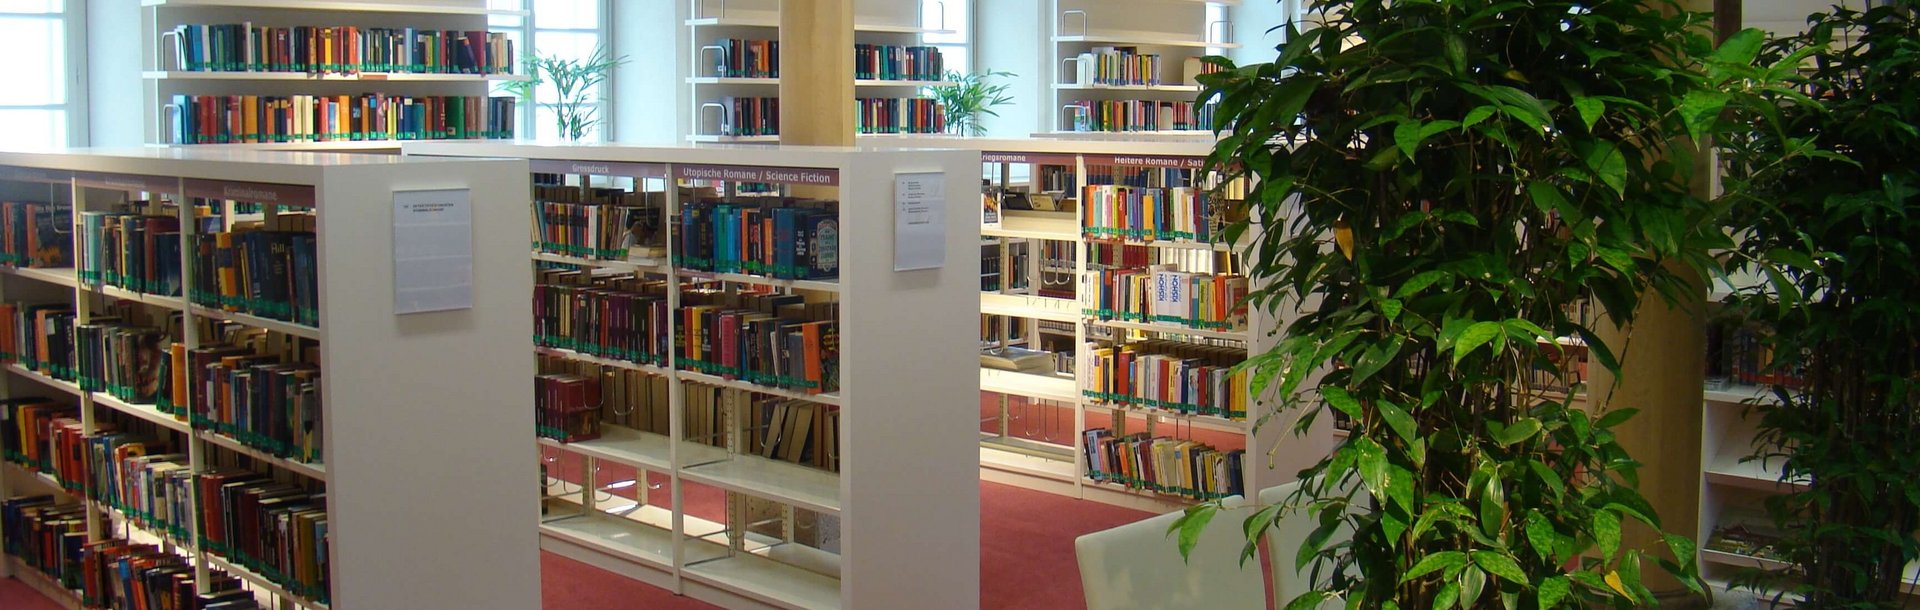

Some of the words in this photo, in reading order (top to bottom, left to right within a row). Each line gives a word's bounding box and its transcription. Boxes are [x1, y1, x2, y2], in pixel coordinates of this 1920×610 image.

[982, 153, 1026, 162] riegsromane
[1114, 156, 1143, 165] Heitere
[1145, 157, 1178, 166] Romane
[1187, 158, 1206, 167] Sati
[572, 164, 609, 174] Grossdruck
[683, 167, 721, 179] Utopische
[724, 169, 756, 180] Romane
[759, 170, 764, 181] /
[766, 170, 799, 182] Science
[801, 171, 831, 184] Fiction
